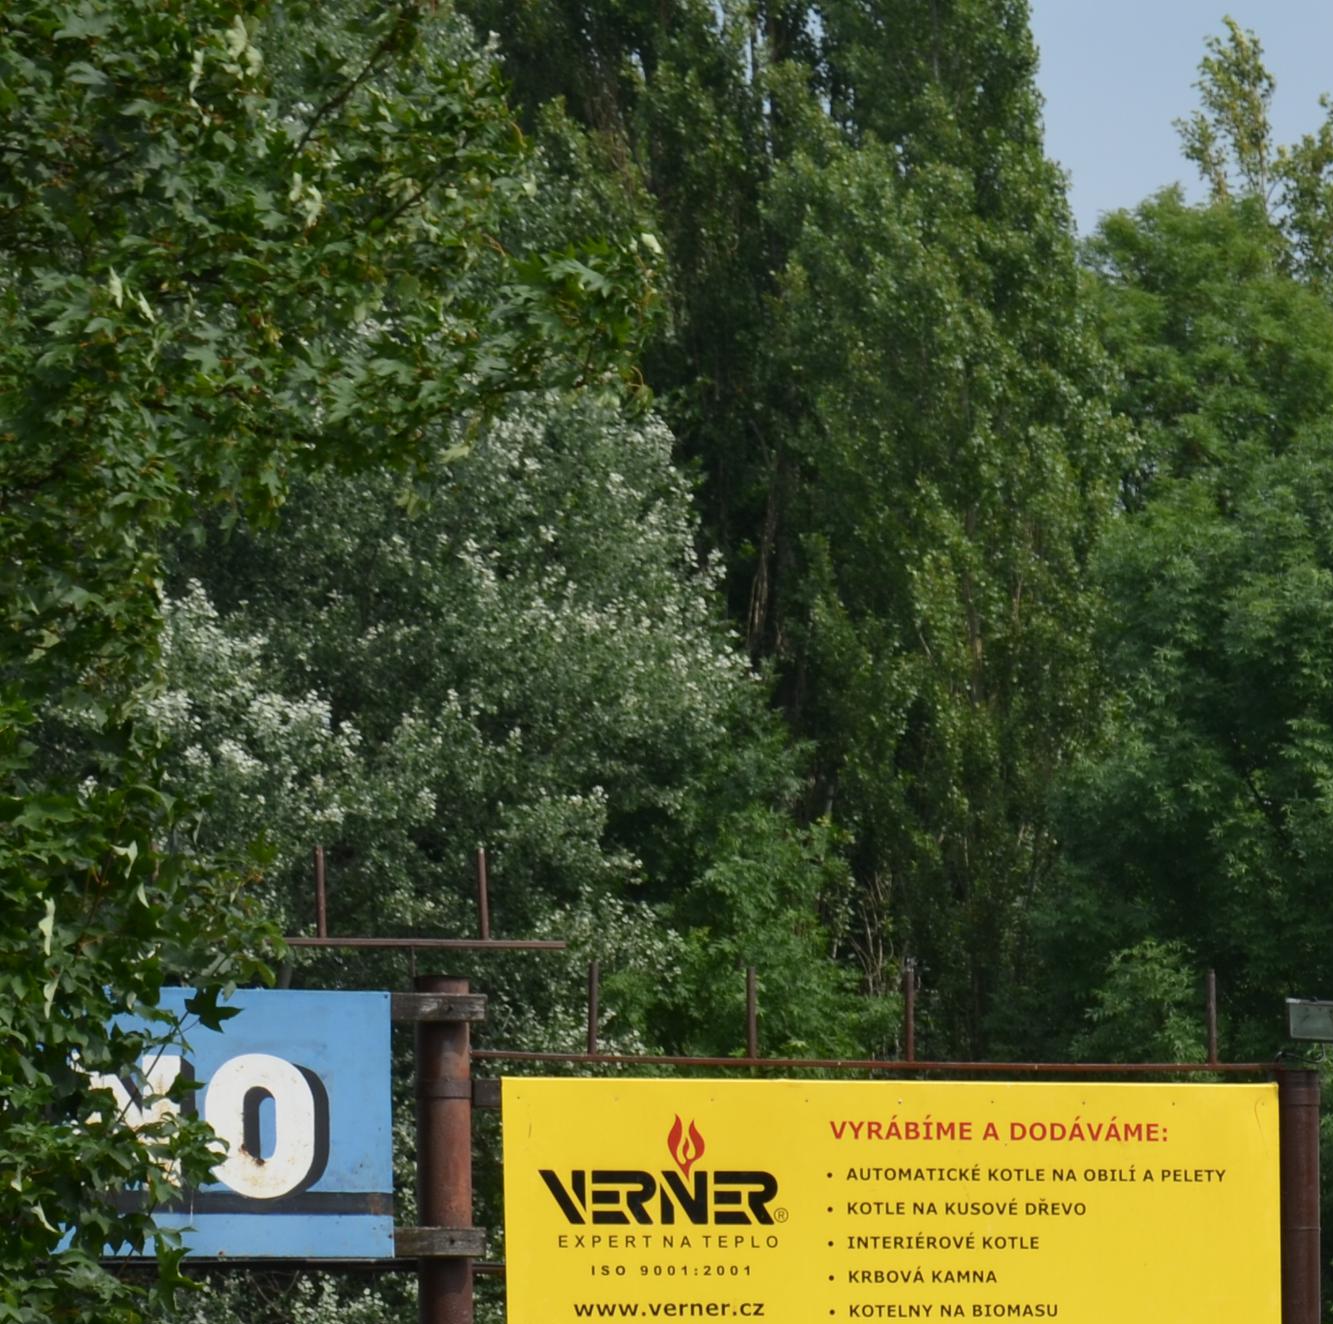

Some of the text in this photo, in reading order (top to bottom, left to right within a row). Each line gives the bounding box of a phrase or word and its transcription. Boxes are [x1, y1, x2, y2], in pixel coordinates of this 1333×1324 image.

[829, 1114, 1168, 1143] VYRÁBÍME A DODÁVÁME:
[846, 1163, 1226, 1183] AUTOMATICKÉ KOTLE NA OBILÍ A PELETY
[537, 1169, 779, 1226] VERNER
[847, 1197, 1087, 1216] KOTLE NA KUSOVÉ DŘEVO
[558, 1234, 779, 1249] EXPERT NA TEPLO
[847, 1231, 1040, 1250] INTERIÉROVÉ KOTLE
[591, 1264, 751, 1277] ISO 9001:2001
[848, 1265, 998, 1284] KRBOVÁ KAMNA
[573, 1302, 765, 1318] www.verner.cz
[848, 1303, 1058, 1318] KOTELNY NA BIOMASU
